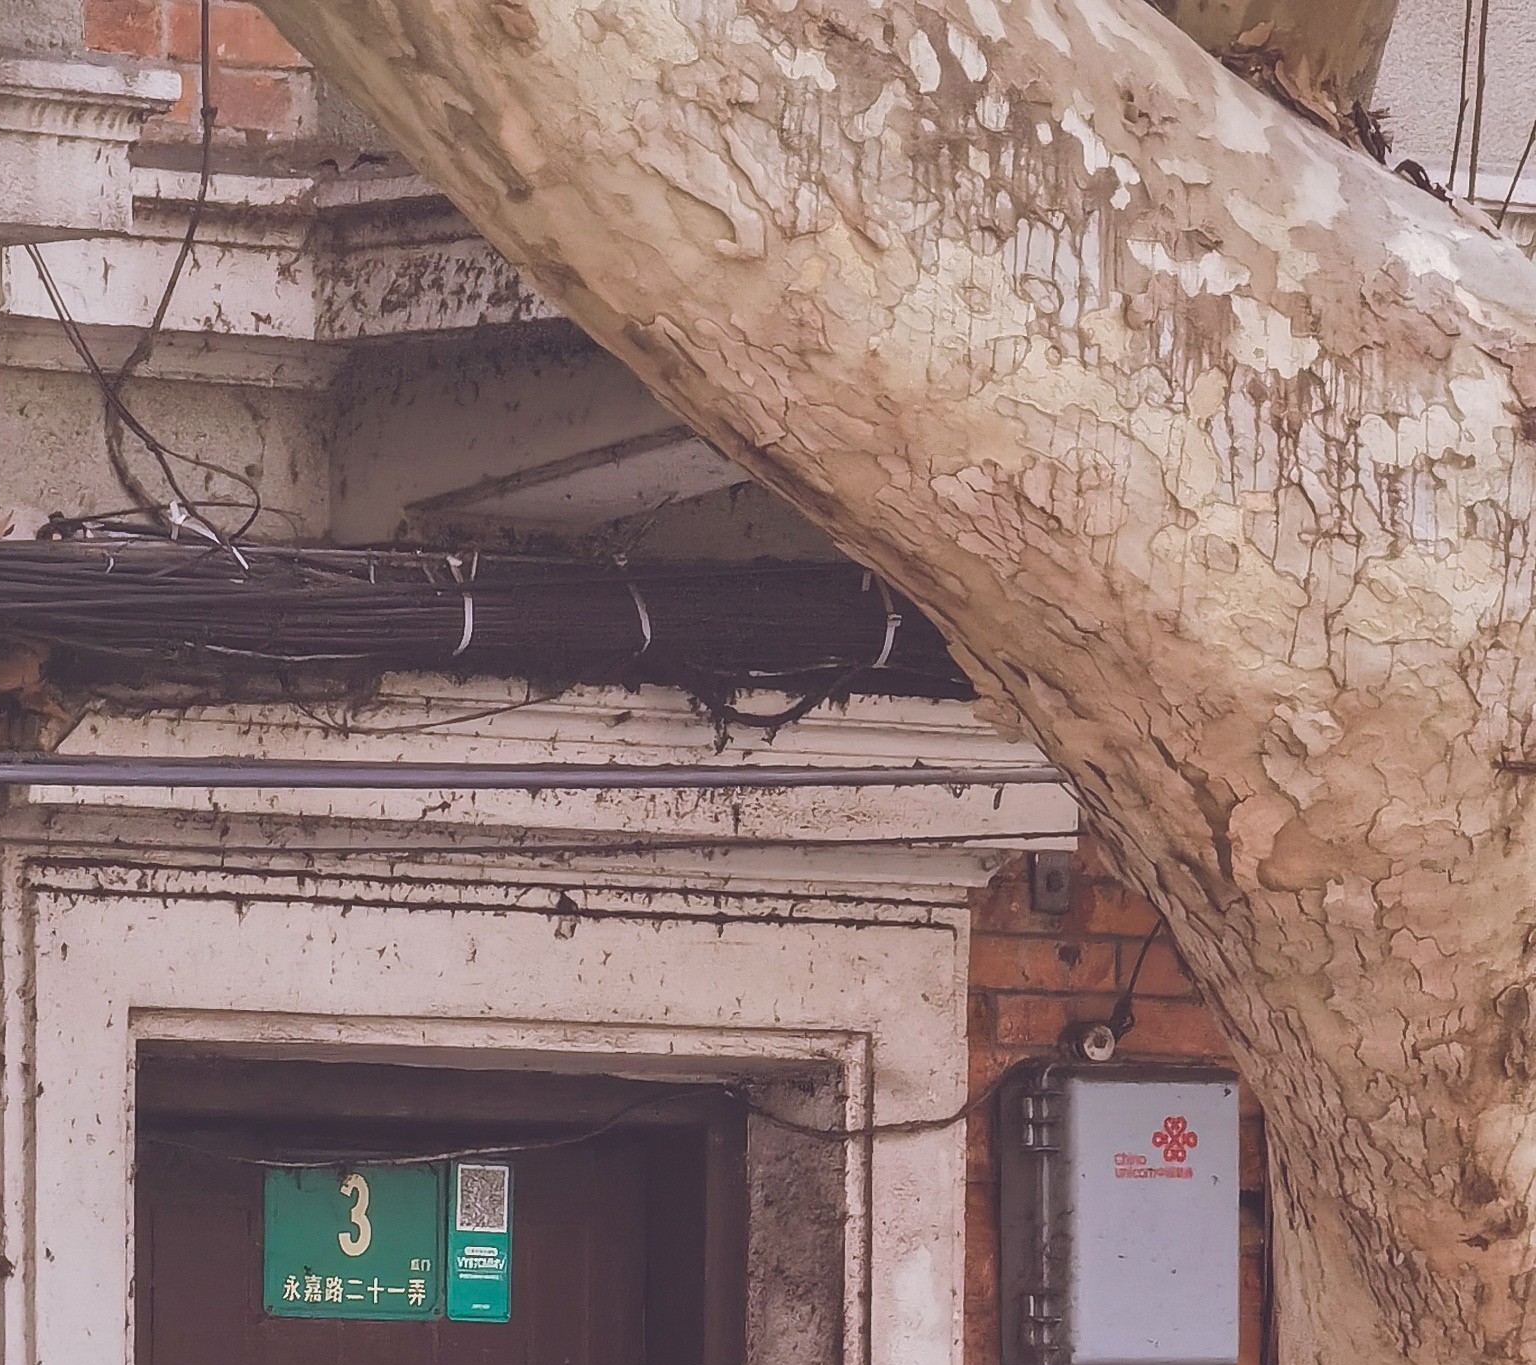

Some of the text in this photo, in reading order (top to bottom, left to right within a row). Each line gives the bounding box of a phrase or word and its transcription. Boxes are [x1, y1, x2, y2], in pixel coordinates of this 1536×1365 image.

[338, 1173, 373, 1257] 3
[282, 1275, 427, 1307] 永嘉路二十一弄
